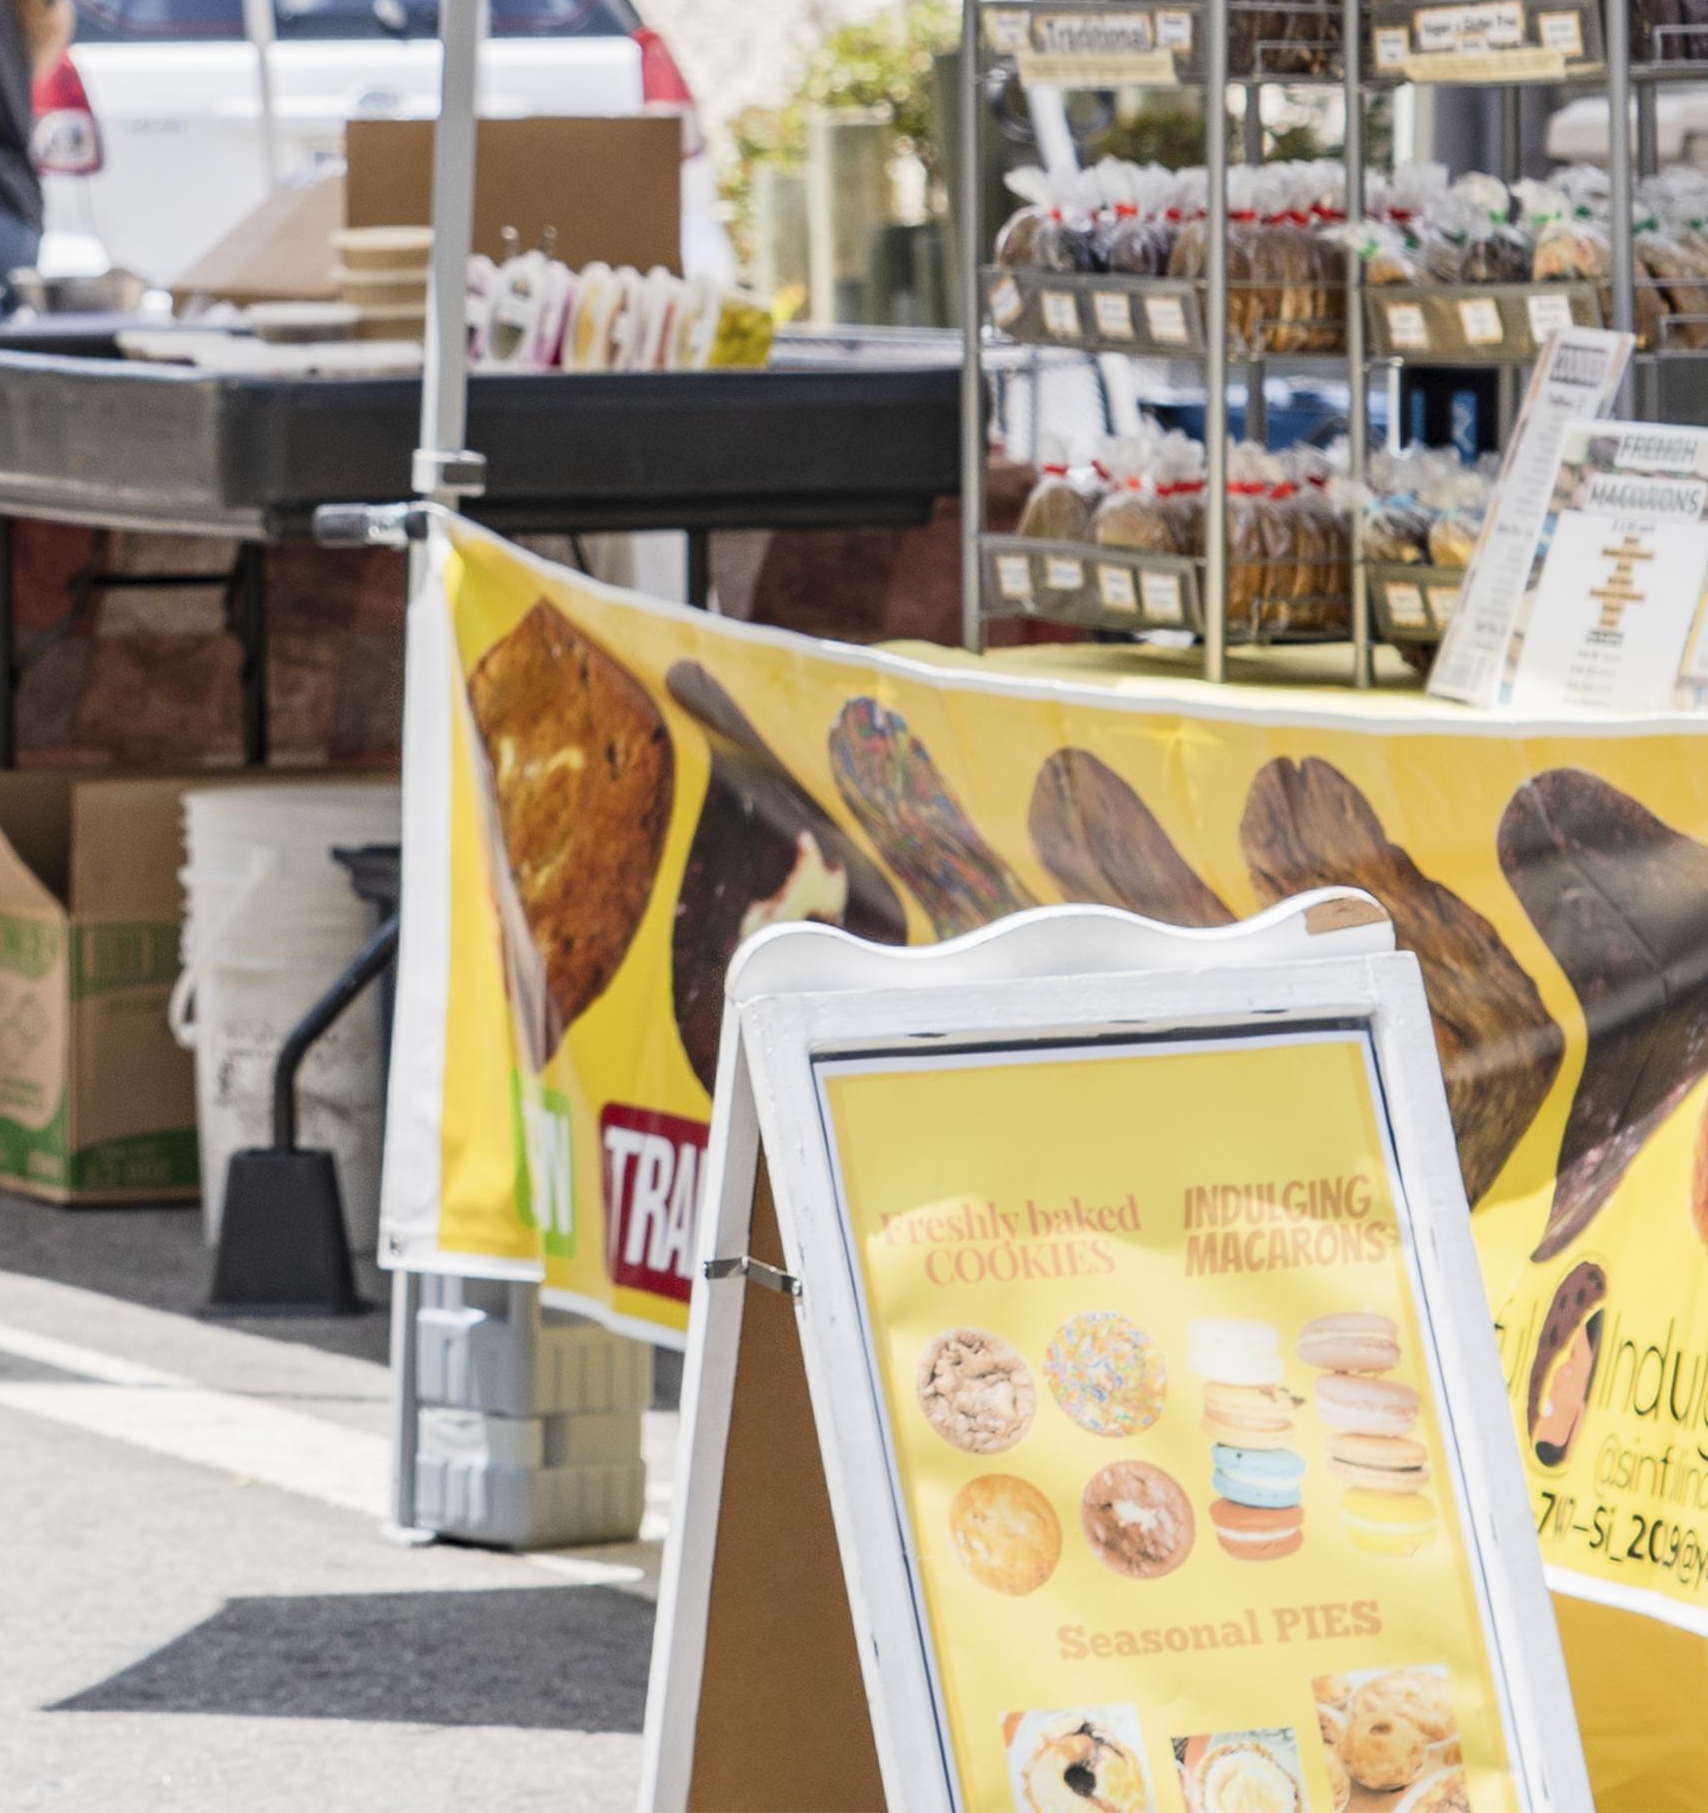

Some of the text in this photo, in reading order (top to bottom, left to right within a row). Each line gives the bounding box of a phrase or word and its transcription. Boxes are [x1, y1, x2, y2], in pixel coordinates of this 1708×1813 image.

[604, 1124, 709, 1280] TRA
[878, 1193, 1143, 1246] Freshly baked
[1184, 1174, 1372, 1230] INDULGING
[924, 1239, 1117, 1286] COOKIES
[1185, 1221, 1389, 1278] MACARONS
[1597, 1306, 1708, 1461] Indul
[1056, 1598, 1383, 1662] Seasonal PIES
